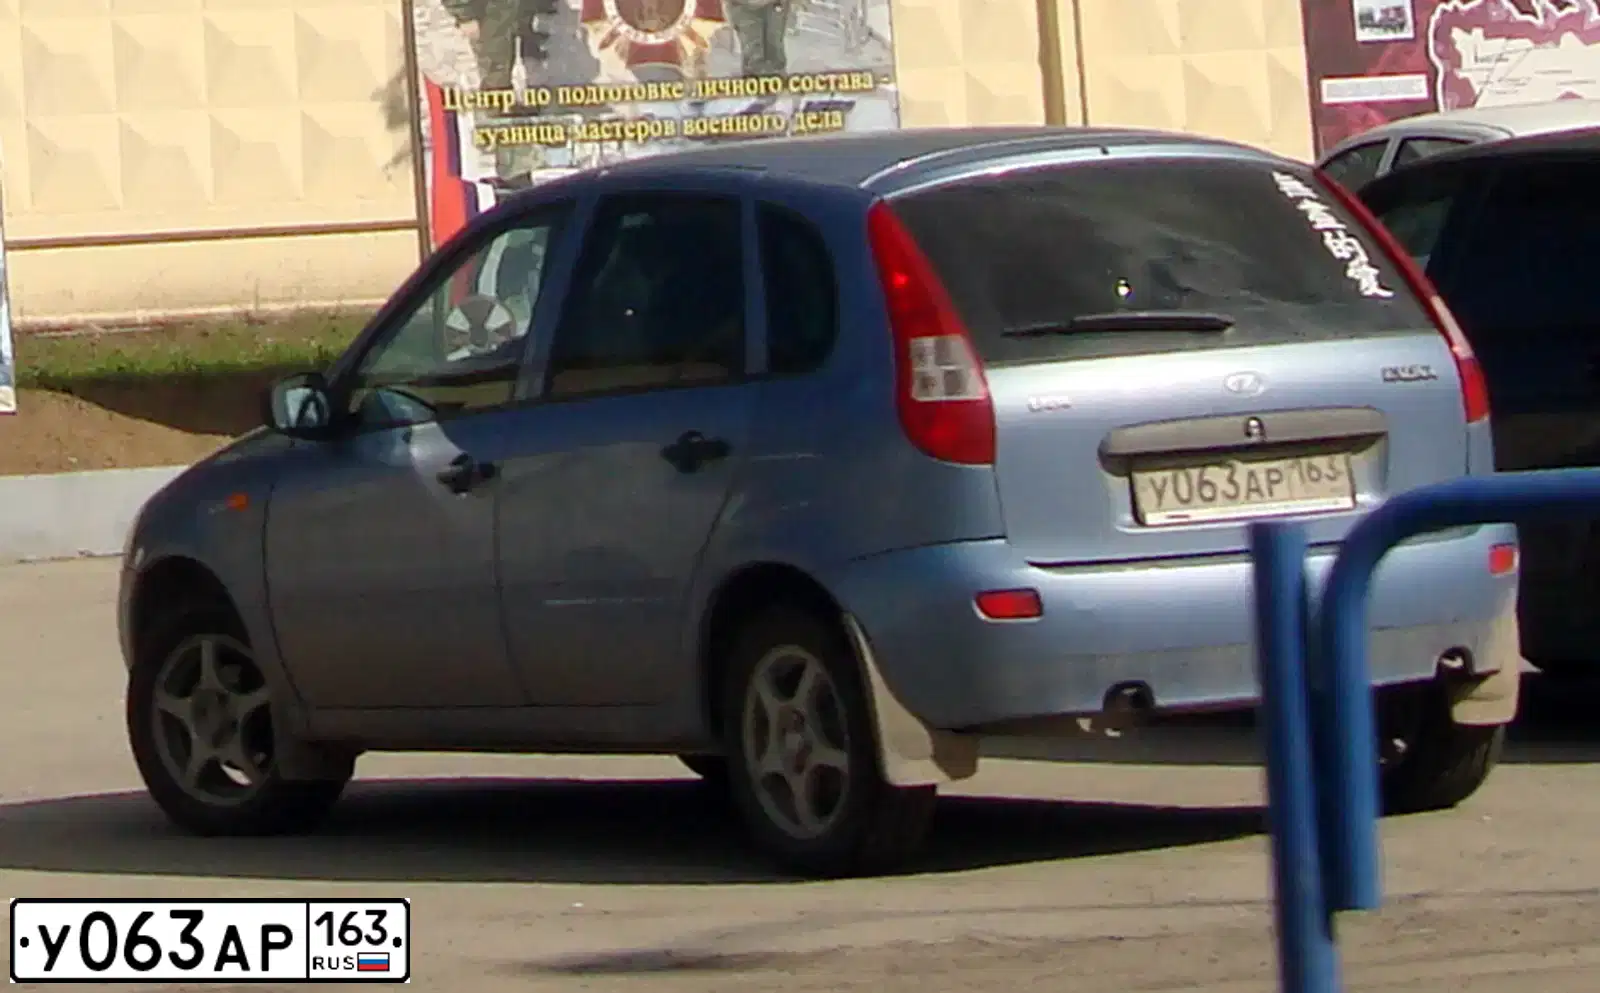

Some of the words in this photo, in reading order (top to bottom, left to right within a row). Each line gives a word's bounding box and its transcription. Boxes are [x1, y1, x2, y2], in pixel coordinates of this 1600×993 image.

[444, 86, 515, 112] Центр
[523, 86, 550, 106] по
[558, 81, 684, 106] подготовке
[691, 75, 781, 98] личного
[789, 71, 873, 93] состава
[475, 122, 565, 149] кузница
[570, 117, 676, 142] мастеров
[684, 112, 785, 136] военного
[795, 109, 843, 134] дела
[1150, 460, 1284, 509] У063АР
[1291, 454, 1343, 486] 163
